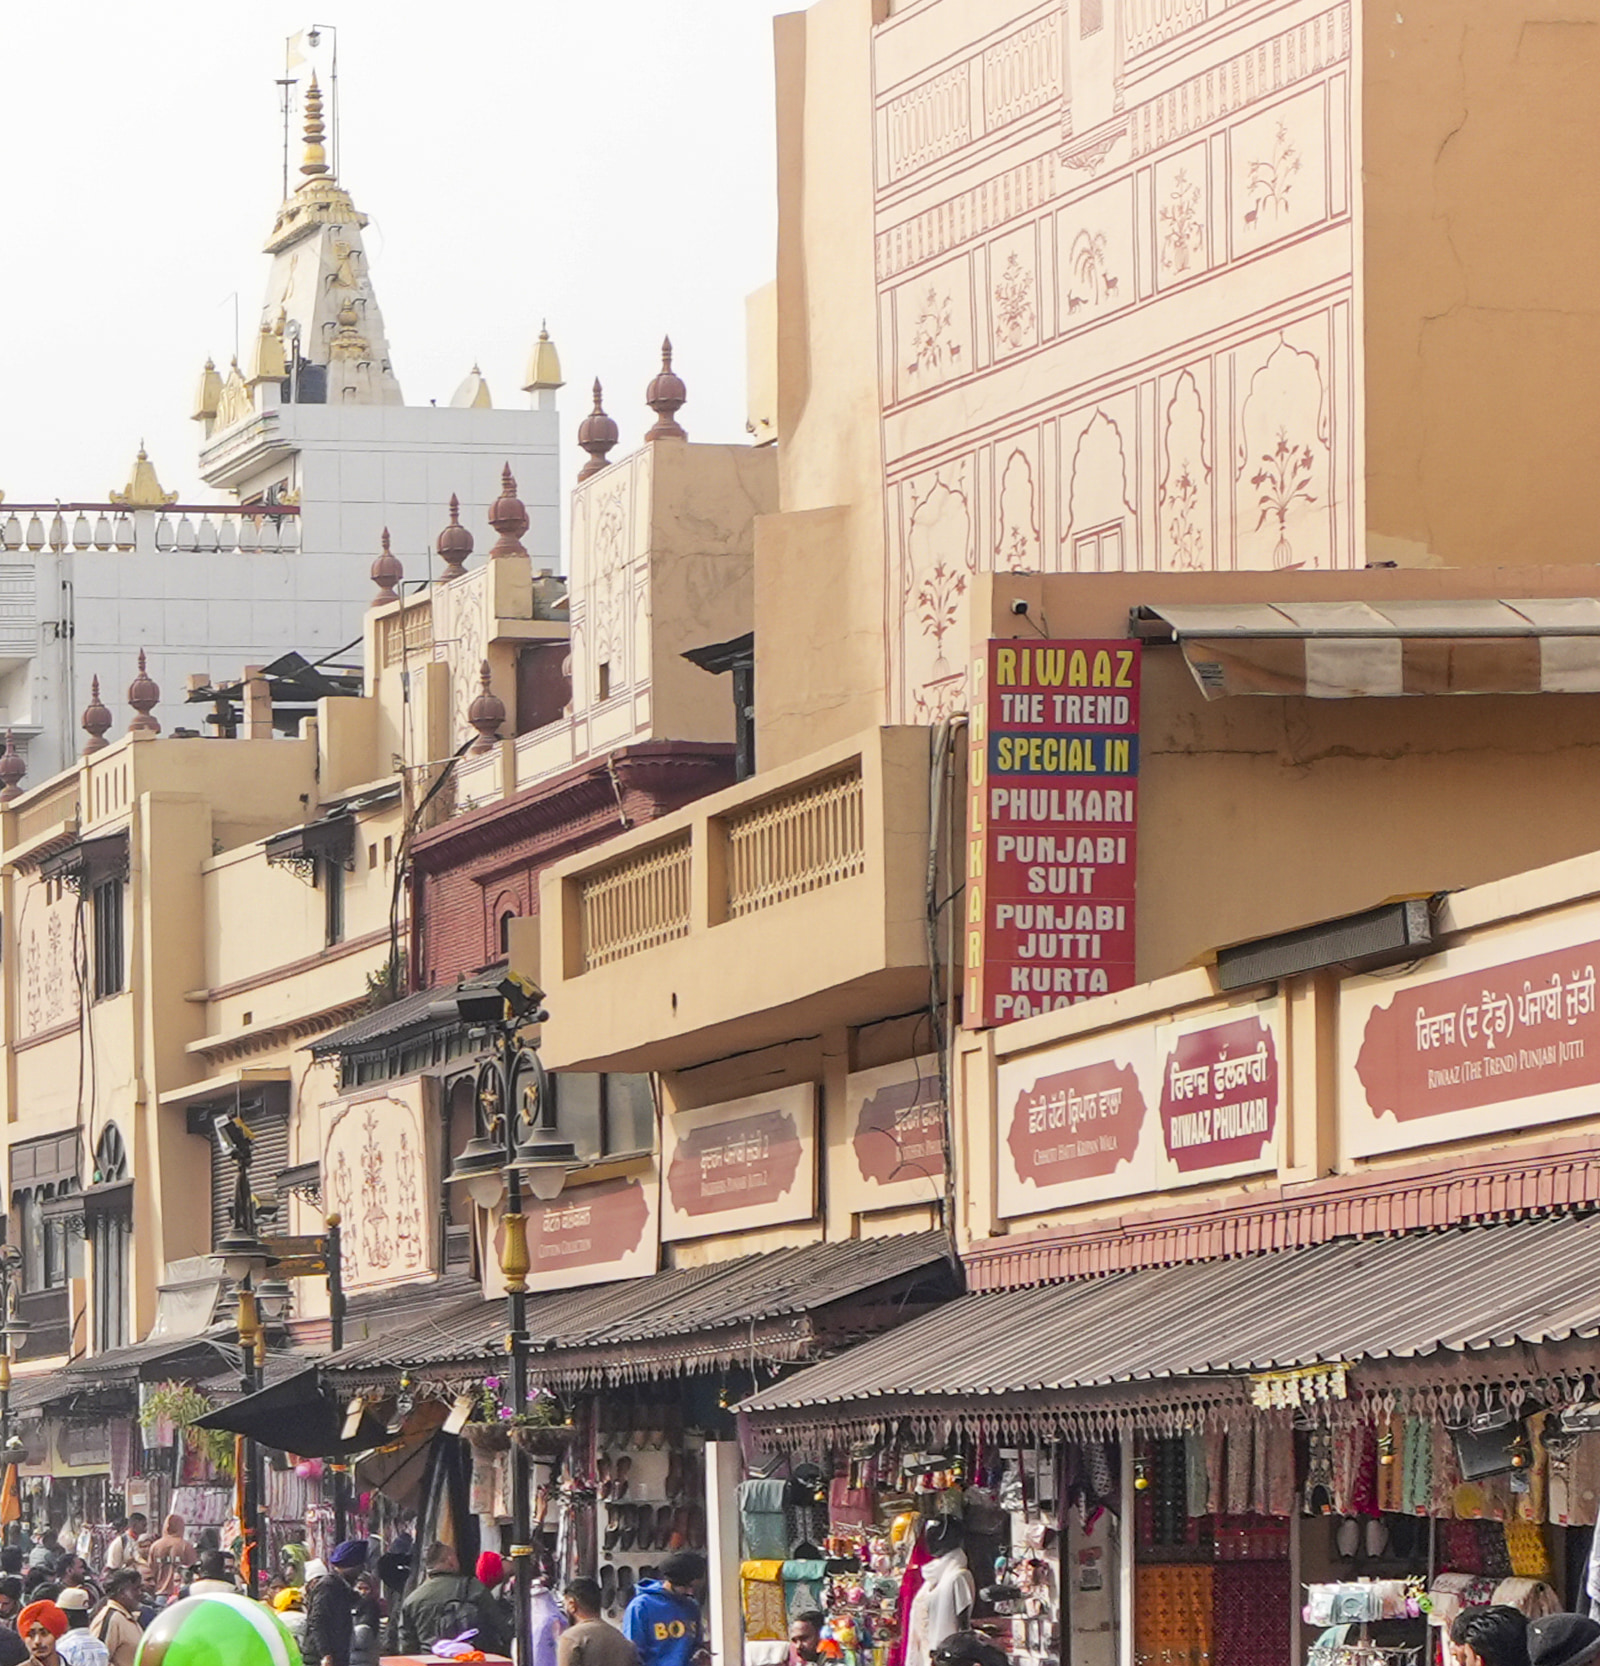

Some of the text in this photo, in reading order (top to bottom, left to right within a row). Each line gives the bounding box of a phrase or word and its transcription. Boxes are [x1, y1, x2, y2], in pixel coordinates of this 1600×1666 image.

[996, 648, 1134, 687] RIWAAZ
[1001, 694, 1129, 725] THE TREND
[997, 737, 1129, 773] SPECIAL IN
[991, 788, 1133, 822] PHULKARI
[969, 657, 985, 1013] PHULKARI
[997, 836, 1126, 864] PUNJABI
[1027, 867, 1096, 894] SUIT
[996, 904, 1125, 931] PUNJABI
[1018, 933, 1101, 959] JUTTI
[1011, 967, 1109, 992] KURTA
[1518, 973, 1562, 1026] ਪੰਜਾਬੀ
[1566, 964, 1595, 1025] ਜੁੱਤੀ
[995, 994, 1100, 1019] PAJA
[1170, 1097, 1268, 1149] RIWAAZ PHULKARI
